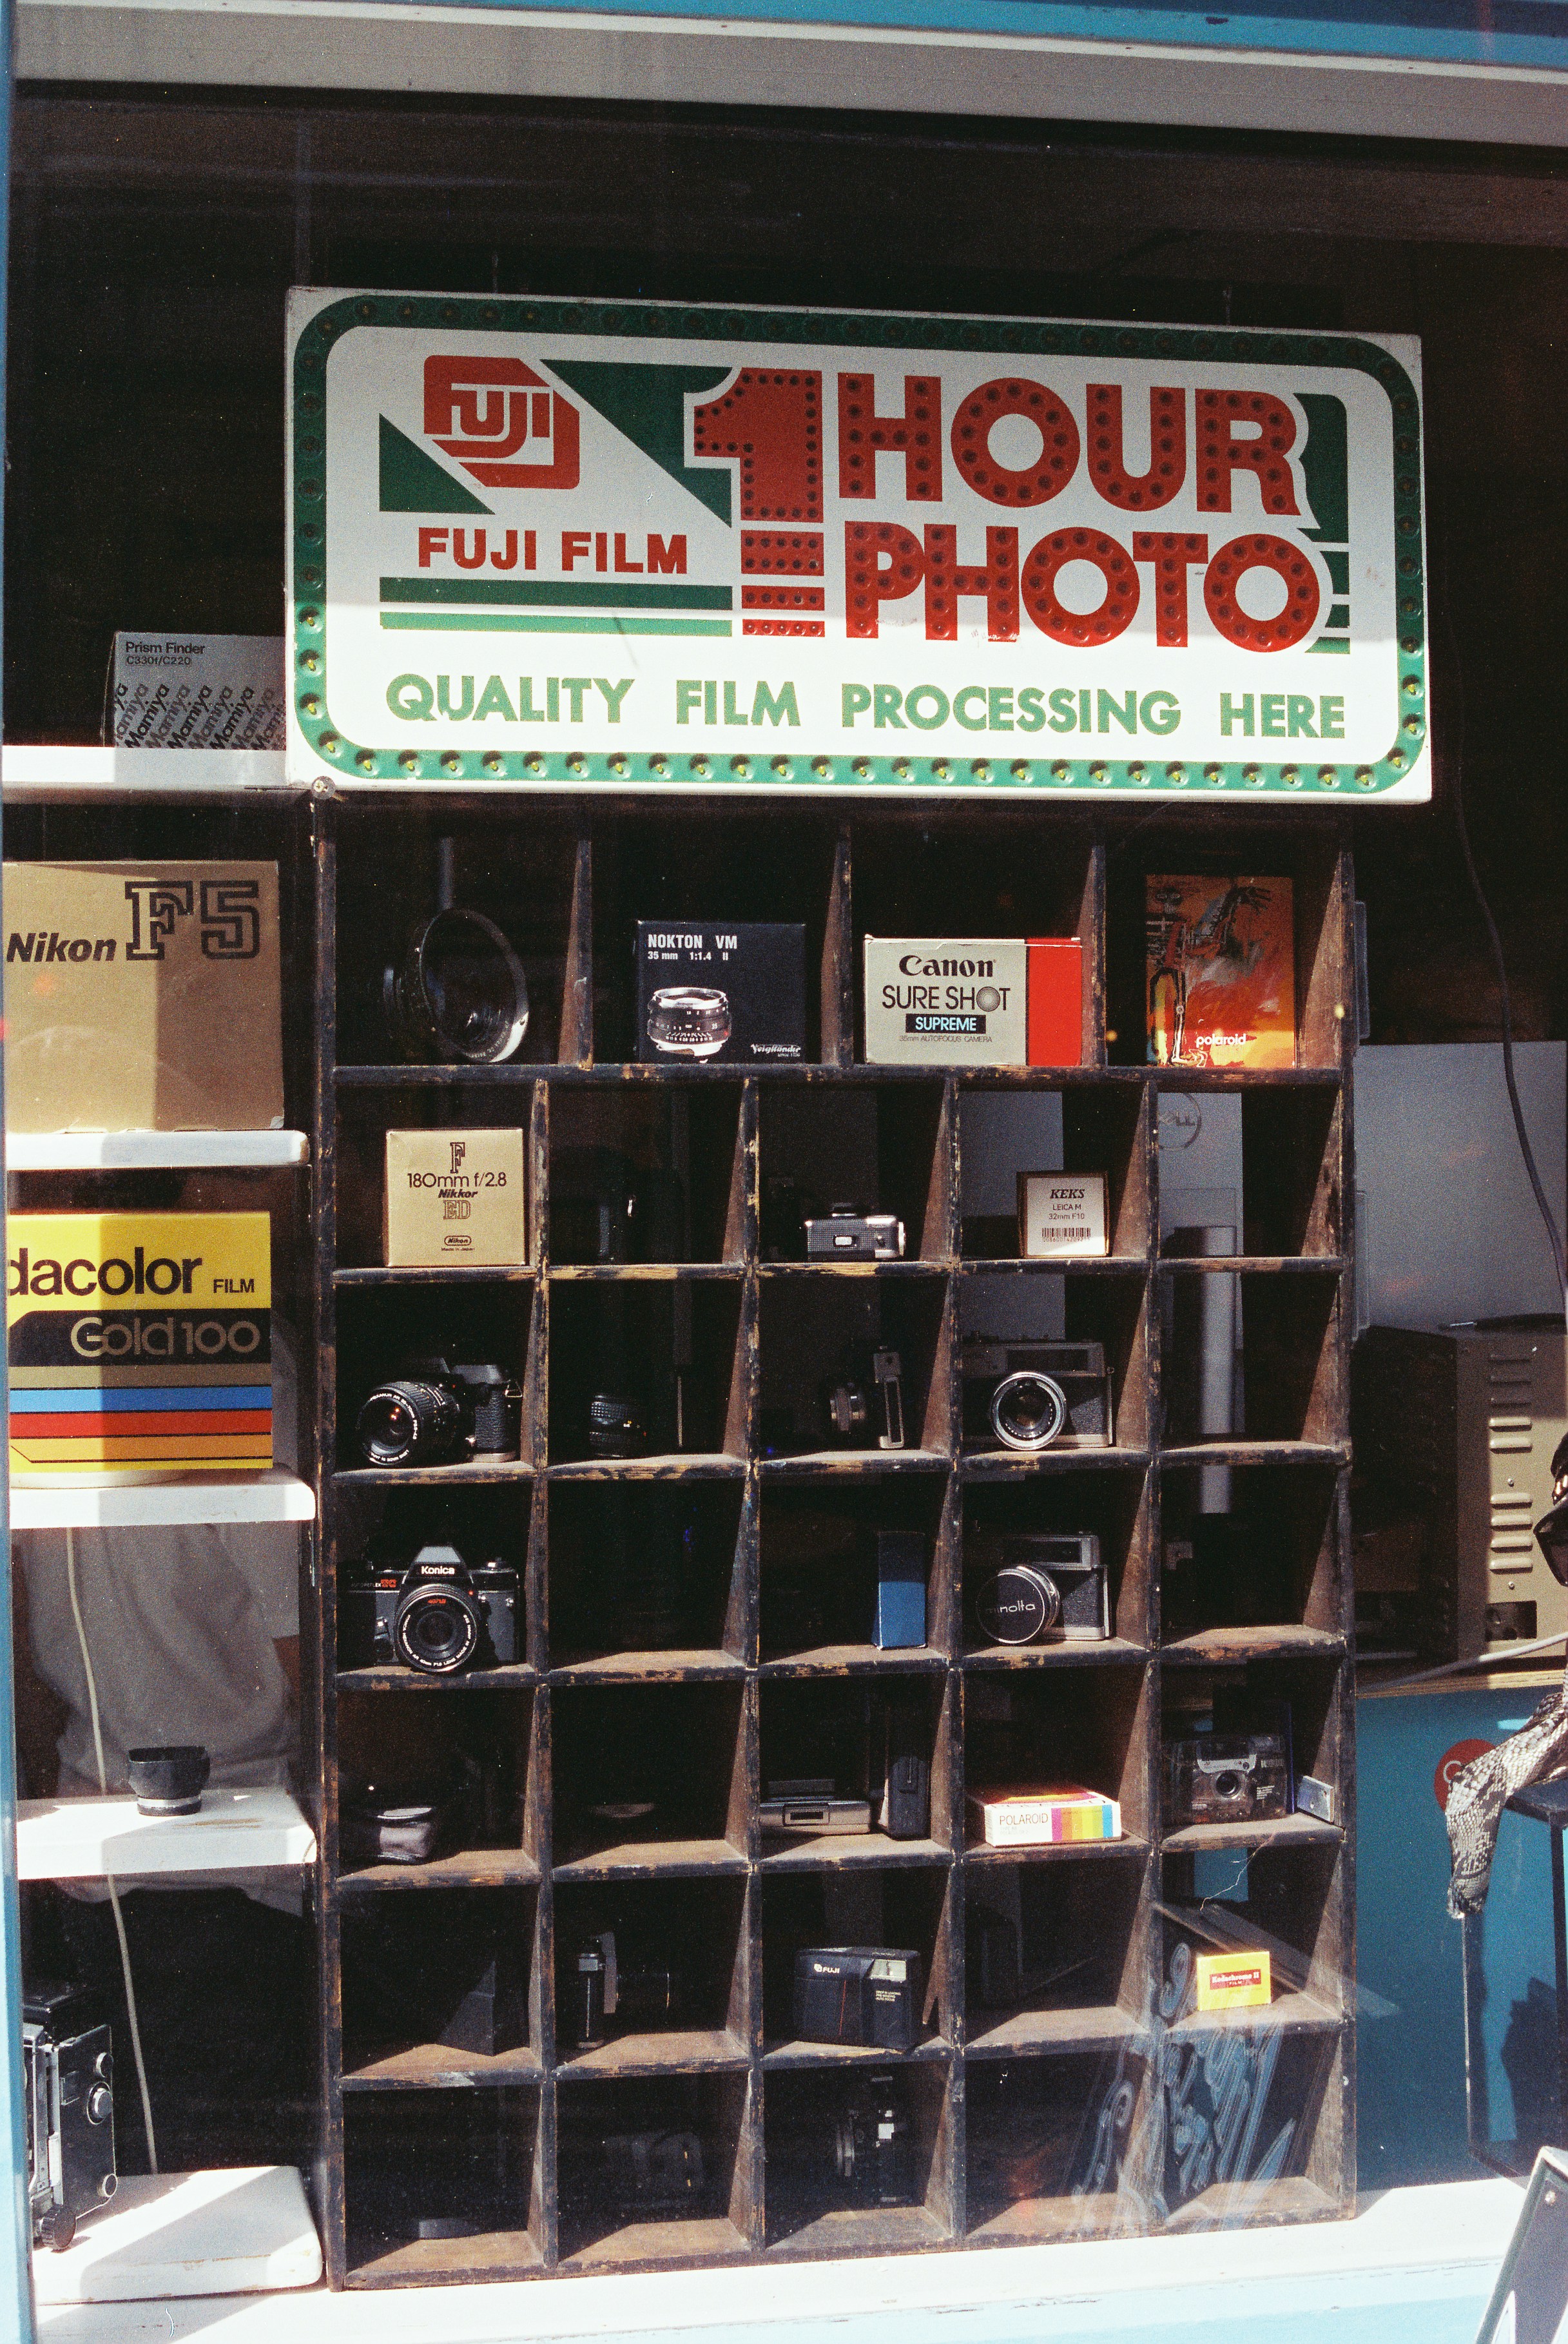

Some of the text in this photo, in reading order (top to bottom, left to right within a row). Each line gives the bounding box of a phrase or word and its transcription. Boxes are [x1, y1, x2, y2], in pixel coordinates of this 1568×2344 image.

[424, 355, 553, 461] FUJI
[693, 367, 1301, 637] 1 HOUR
[418, 527, 688, 574] FUJI FILM
[844, 521, 1321, 653] PHOTO
[126, 641, 206, 654] Prism Finder
[116, 684, 149, 740] amiya
[124, 684, 169, 748] Mamiya
[168, 685, 213, 749] Mamiya
[386, 673, 1345, 739] QUALITY FILM PROCESSING HERE
[210, 686, 255, 750] Mamiya
[6, 880, 259, 962] Nikon F5
[648, 935, 737, 949] NOKTON VM
[648, 951, 659, 960] 35
[690, 952, 711, 960] 1:1.4
[899, 954, 993, 977] Canon
[882, 985, 1011, 1012] SURE SHOT
[915, 1016, 976, 1031] SUPREME
[1196, 1033, 1246, 1048] polaroid
[450, 1141, 465, 1174] F
[407, 1172, 507, 1188] 180mm f/2.8
[438, 1189, 478, 1198] Nikkor
[1050, 1189, 1085, 1199] KEKS
[443, 1199, 471, 1220] ED
[213, 1278, 255, 1293] FILM
[421, 1566, 454, 1574] Konica
[1000, 1813, 1049, 1825] POLAROID
[1212, 1973, 1252, 1983] Kodachrome
